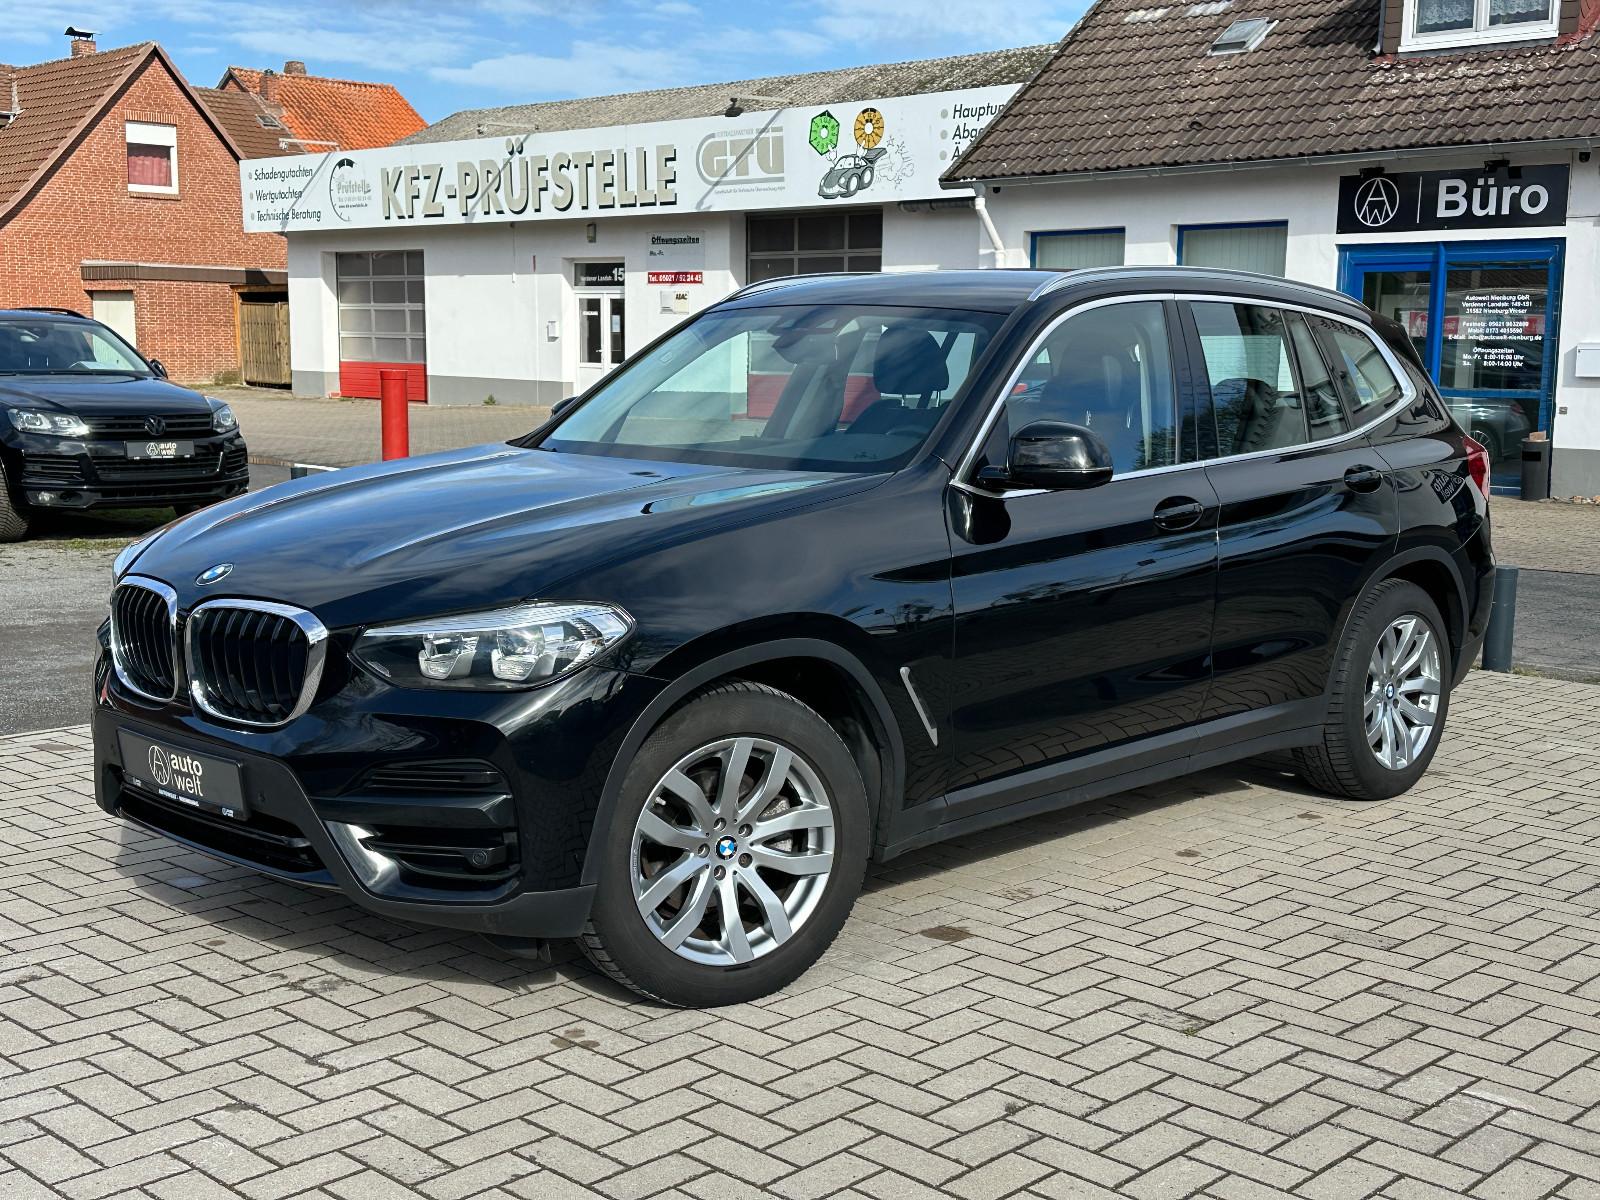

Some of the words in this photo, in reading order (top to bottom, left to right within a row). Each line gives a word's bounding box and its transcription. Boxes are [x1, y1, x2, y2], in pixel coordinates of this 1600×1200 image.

[254, 165, 312, 182] Schadengutachten
[380, 138, 677, 220] KFZ-PRÜFSTELLE
[256, 186, 302, 203] Wertgutachten
[1437, 178, 1548, 217] Büro
[257, 208, 289, 222] Technische
[292, 209, 321, 222] Beratung
[652, 234, 700, 244] Öffnungszeiten
[170, 754, 202, 776] auto
[174, 774, 203, 796] welt
